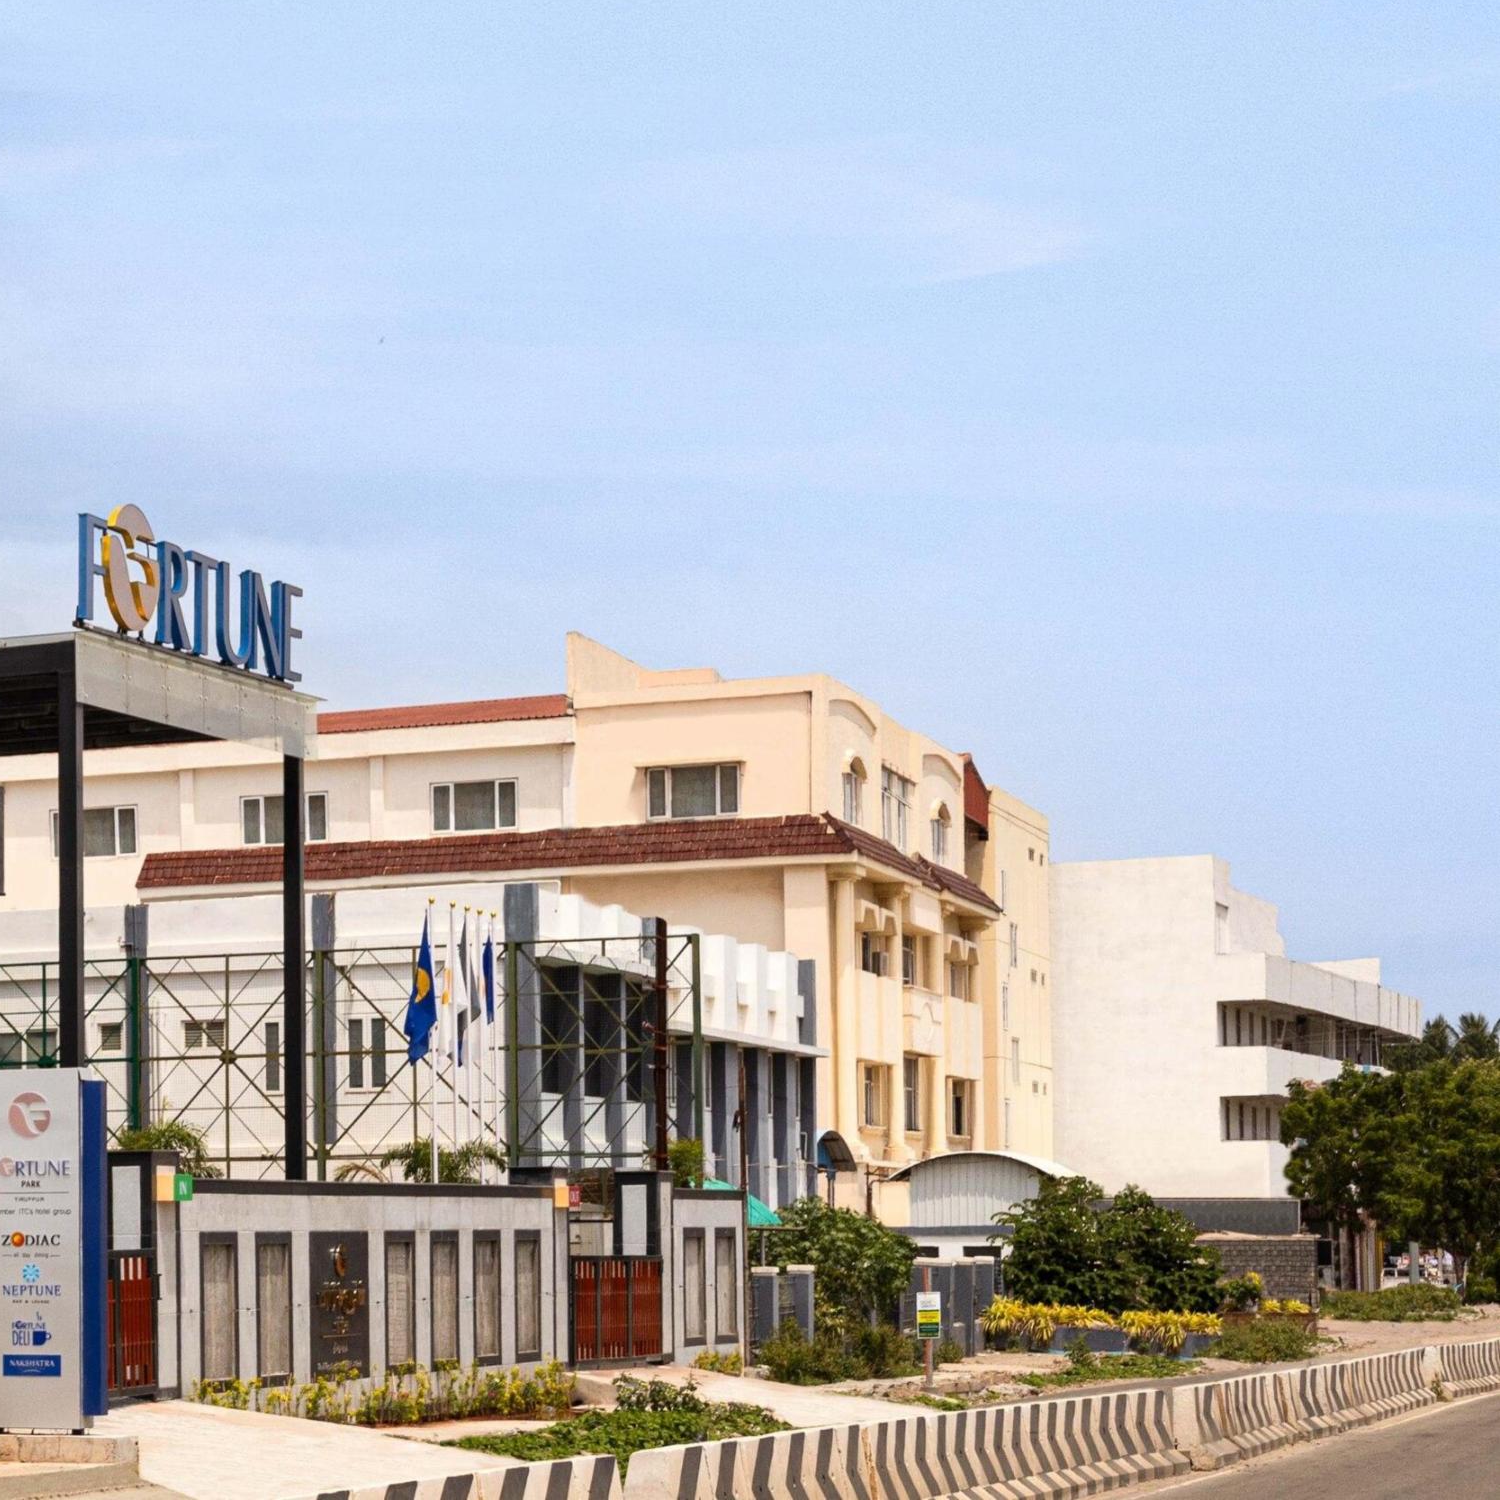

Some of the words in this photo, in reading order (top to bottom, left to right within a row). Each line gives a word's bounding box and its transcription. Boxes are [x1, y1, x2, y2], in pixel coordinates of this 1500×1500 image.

[78, 504, 304, 683] FORTUNE
[21, 1180, 41, 1188] PARK
[53, 1208, 72, 1216] group
[1, 1231, 61, 1248] ZODIAC
[2, 1285, 62, 1297] NEPTUNE
[12, 1330, 30, 1346] DELI
